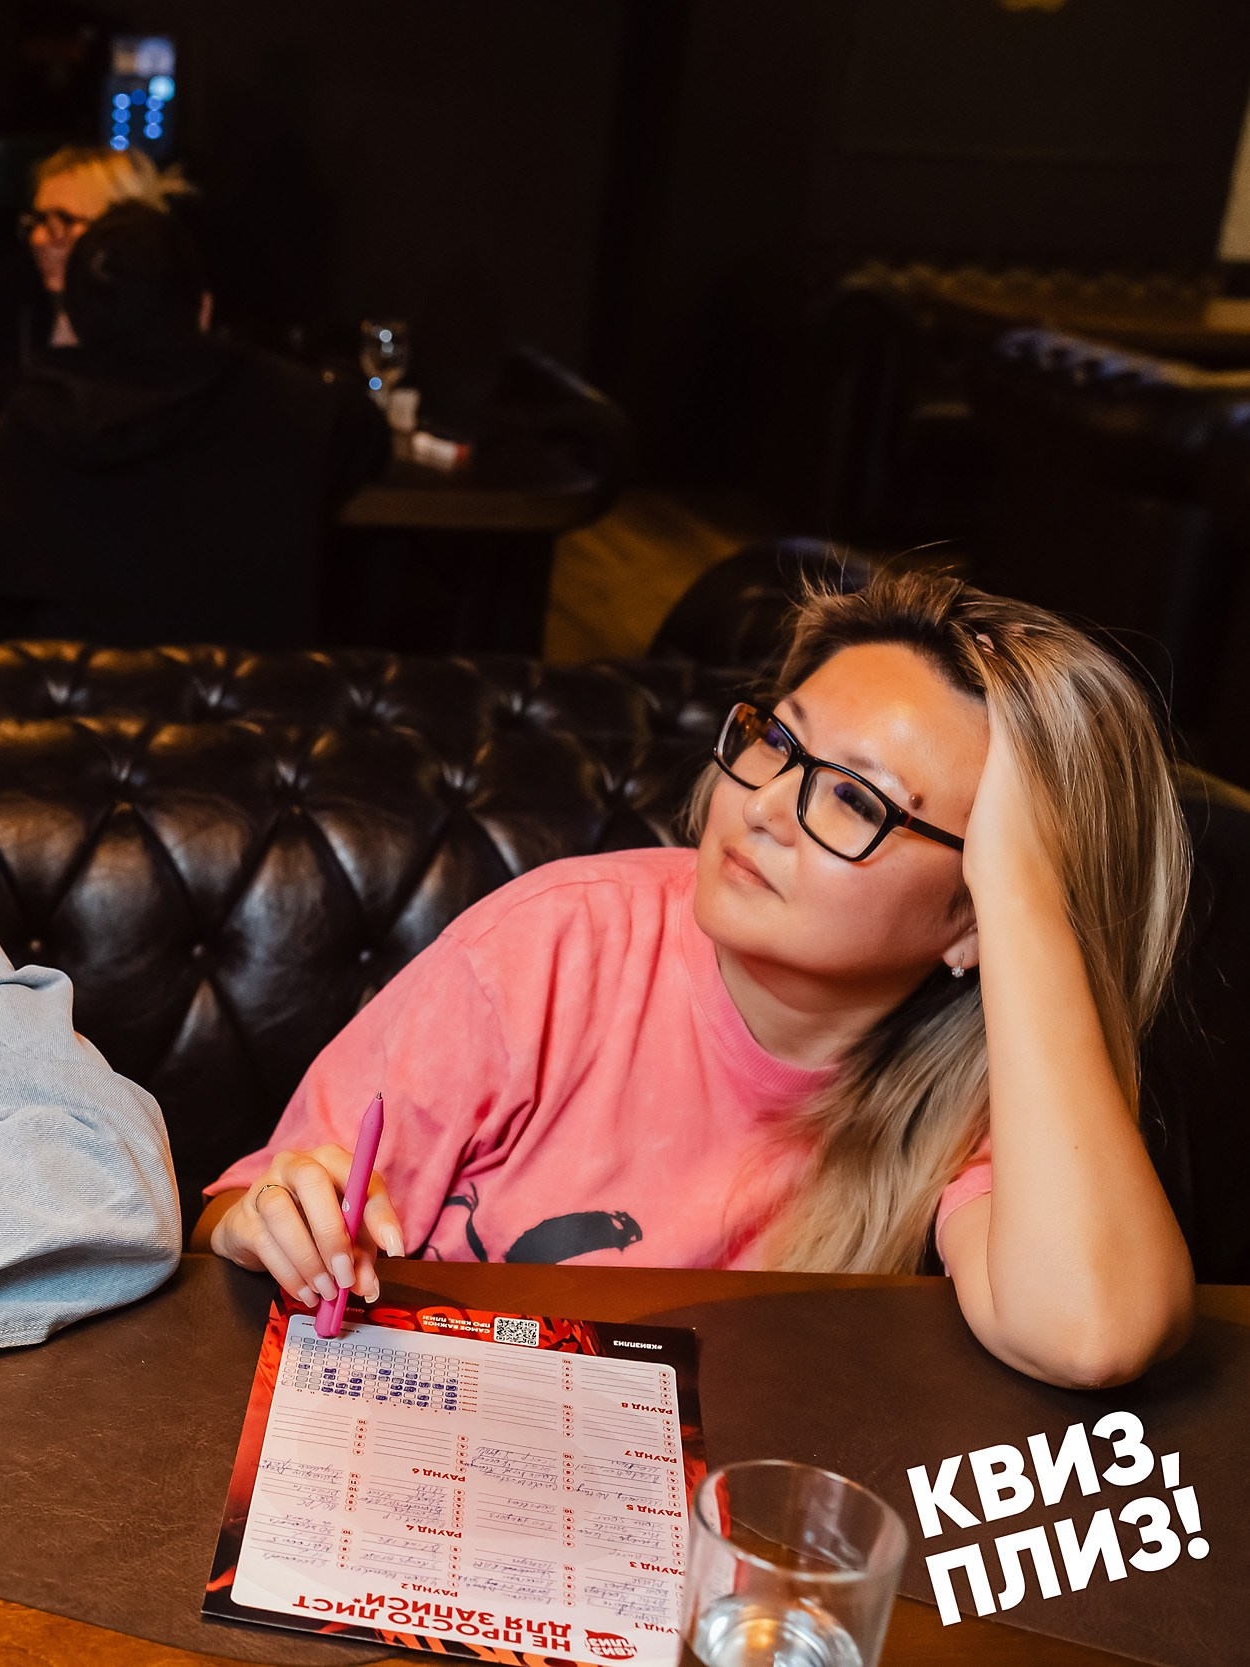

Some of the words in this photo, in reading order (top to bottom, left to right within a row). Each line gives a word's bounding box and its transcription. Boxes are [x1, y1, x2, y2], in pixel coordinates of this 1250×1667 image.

[422, 1320, 458, 1330] ВАЖНОЕ
[460, 1324, 490, 1334] САМОЕ
[612, 1340, 663, 1350] #КВИЗПЛИЗ
[632, 1402, 672, 1414] РАУНД
[634, 1450, 678, 1464] РАУНД
[422, 1468, 466, 1482] РАУНД
[636, 1504, 682, 1518] РАУНД
[417, 1525, 462, 1538] РАУНД
[412, 1584, 458, 1598] РАУНД
[292, 1595, 379, 1620] ЛИСТ
[388, 1612, 522, 1644] ПРОСТО
[505, 1616, 572, 1638] ДЛЯ
[644, 1622, 680, 1635] УНД
[532, 1634, 570, 1652] НЕ
